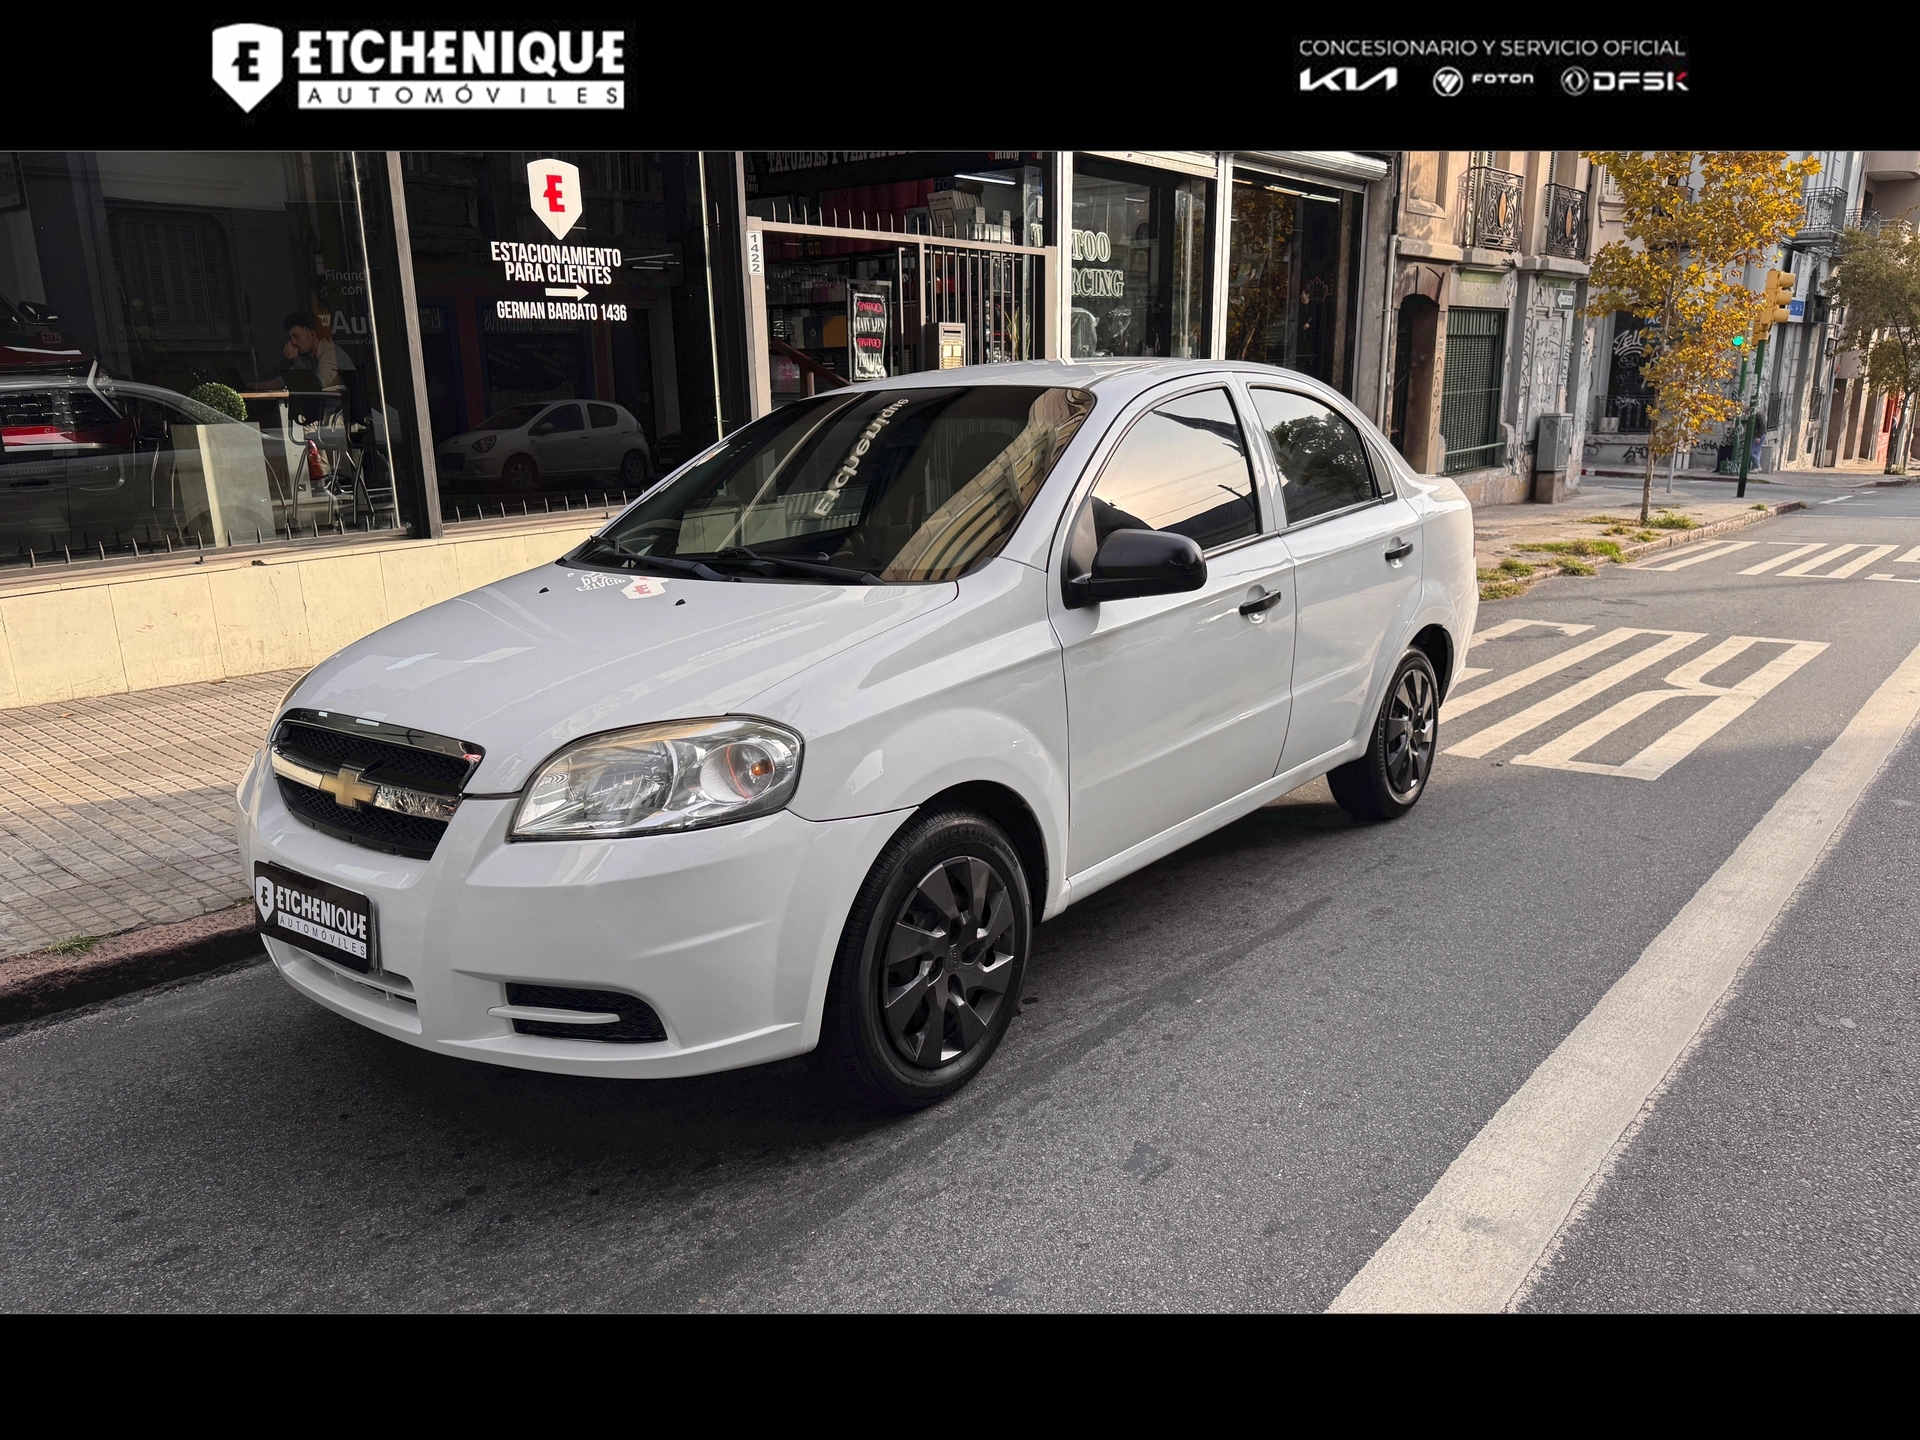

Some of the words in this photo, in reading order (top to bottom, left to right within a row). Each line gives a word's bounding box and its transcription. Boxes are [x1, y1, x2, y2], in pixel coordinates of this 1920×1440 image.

[543, 174, 565, 213] E
[490, 241, 622, 267] ESTACIONAMIENTO
[750, 234, 761, 273] 1422
[504, 262, 544, 282] PARA
[547, 264, 612, 285] CLIENTES
[341, 286, 363, 295] con
[496, 301, 545, 320] GERMAN
[547, 302, 597, 321] BARBATO
[600, 304, 628, 321] 1436
[275, 885, 367, 940] ETCHENIQUE
[279, 915, 365, 956] AUTOMÓVILES
